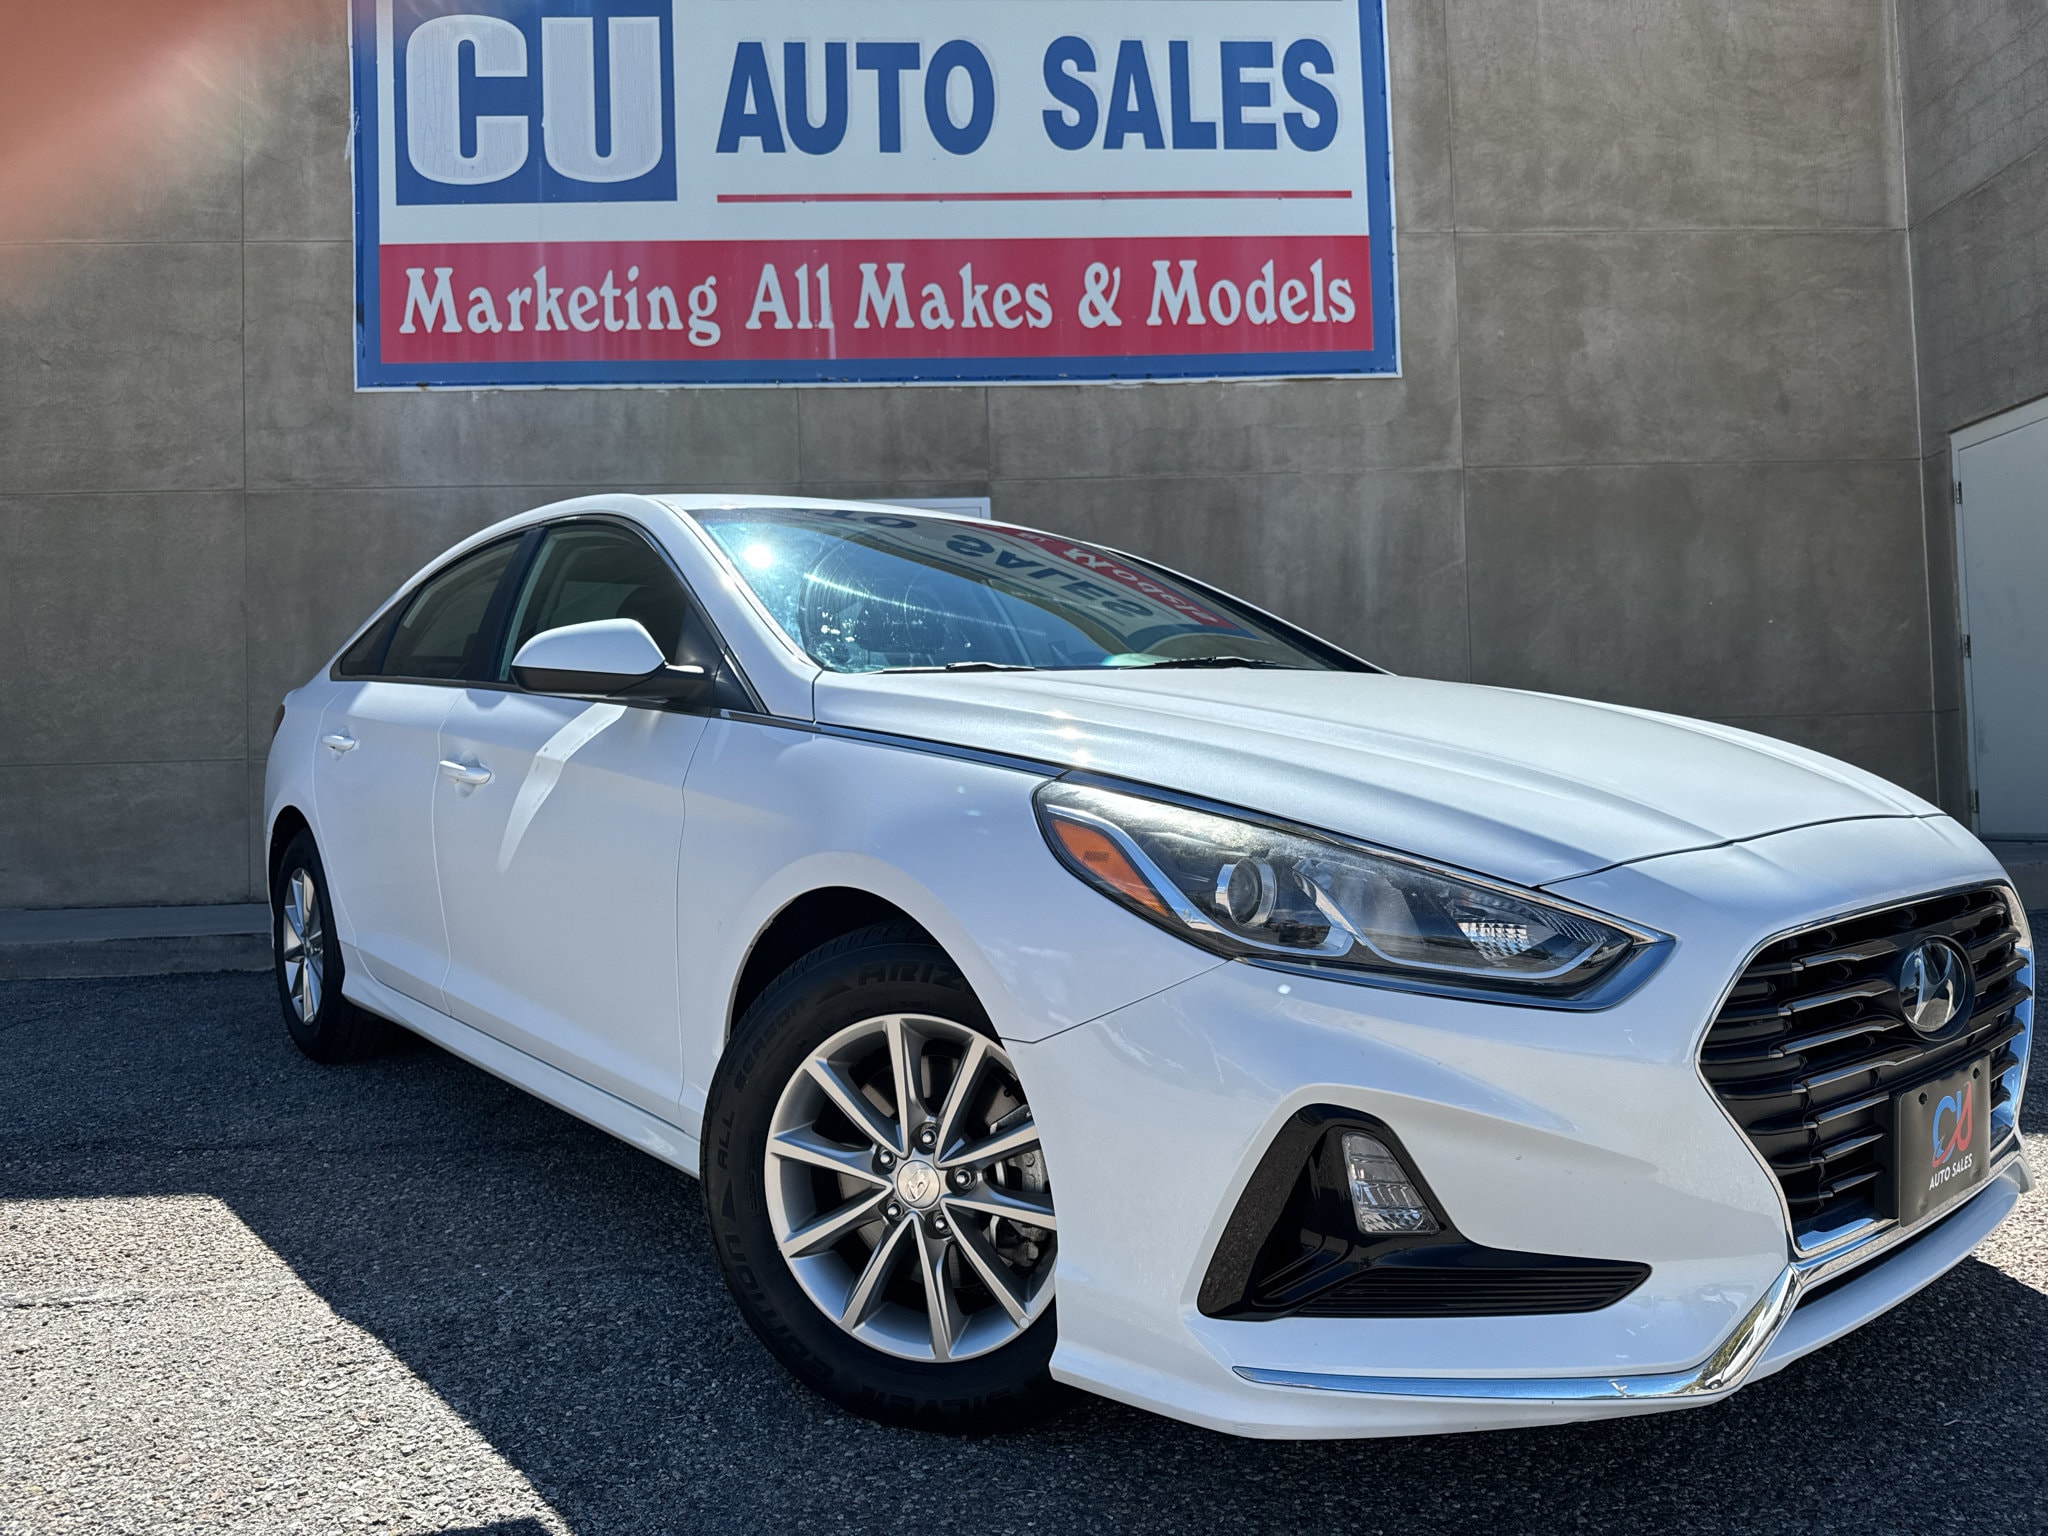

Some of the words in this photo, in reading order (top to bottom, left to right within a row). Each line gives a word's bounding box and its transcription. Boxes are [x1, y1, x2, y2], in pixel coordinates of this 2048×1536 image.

[405, 13, 665, 185] CU
[716, 38, 996, 156] AUTO
[1042, 35, 1341, 152] SALES
[399, 264, 719, 347] Marketing
[745, 261, 833, 332] All
[853, 262, 1053, 330] Makes
[1078, 261, 1123, 328] &
[1146, 257, 1357, 326] Models
[857, 958, 972, 993] ARIZ
[734, 998, 807, 1093] SEASON
[716, 1110, 736, 1171] ALL
[1928, 1167, 1951, 1191] AUTO
[1951, 1153, 1973, 1178] SALES
[724, 1234, 834, 1386] EDITION
